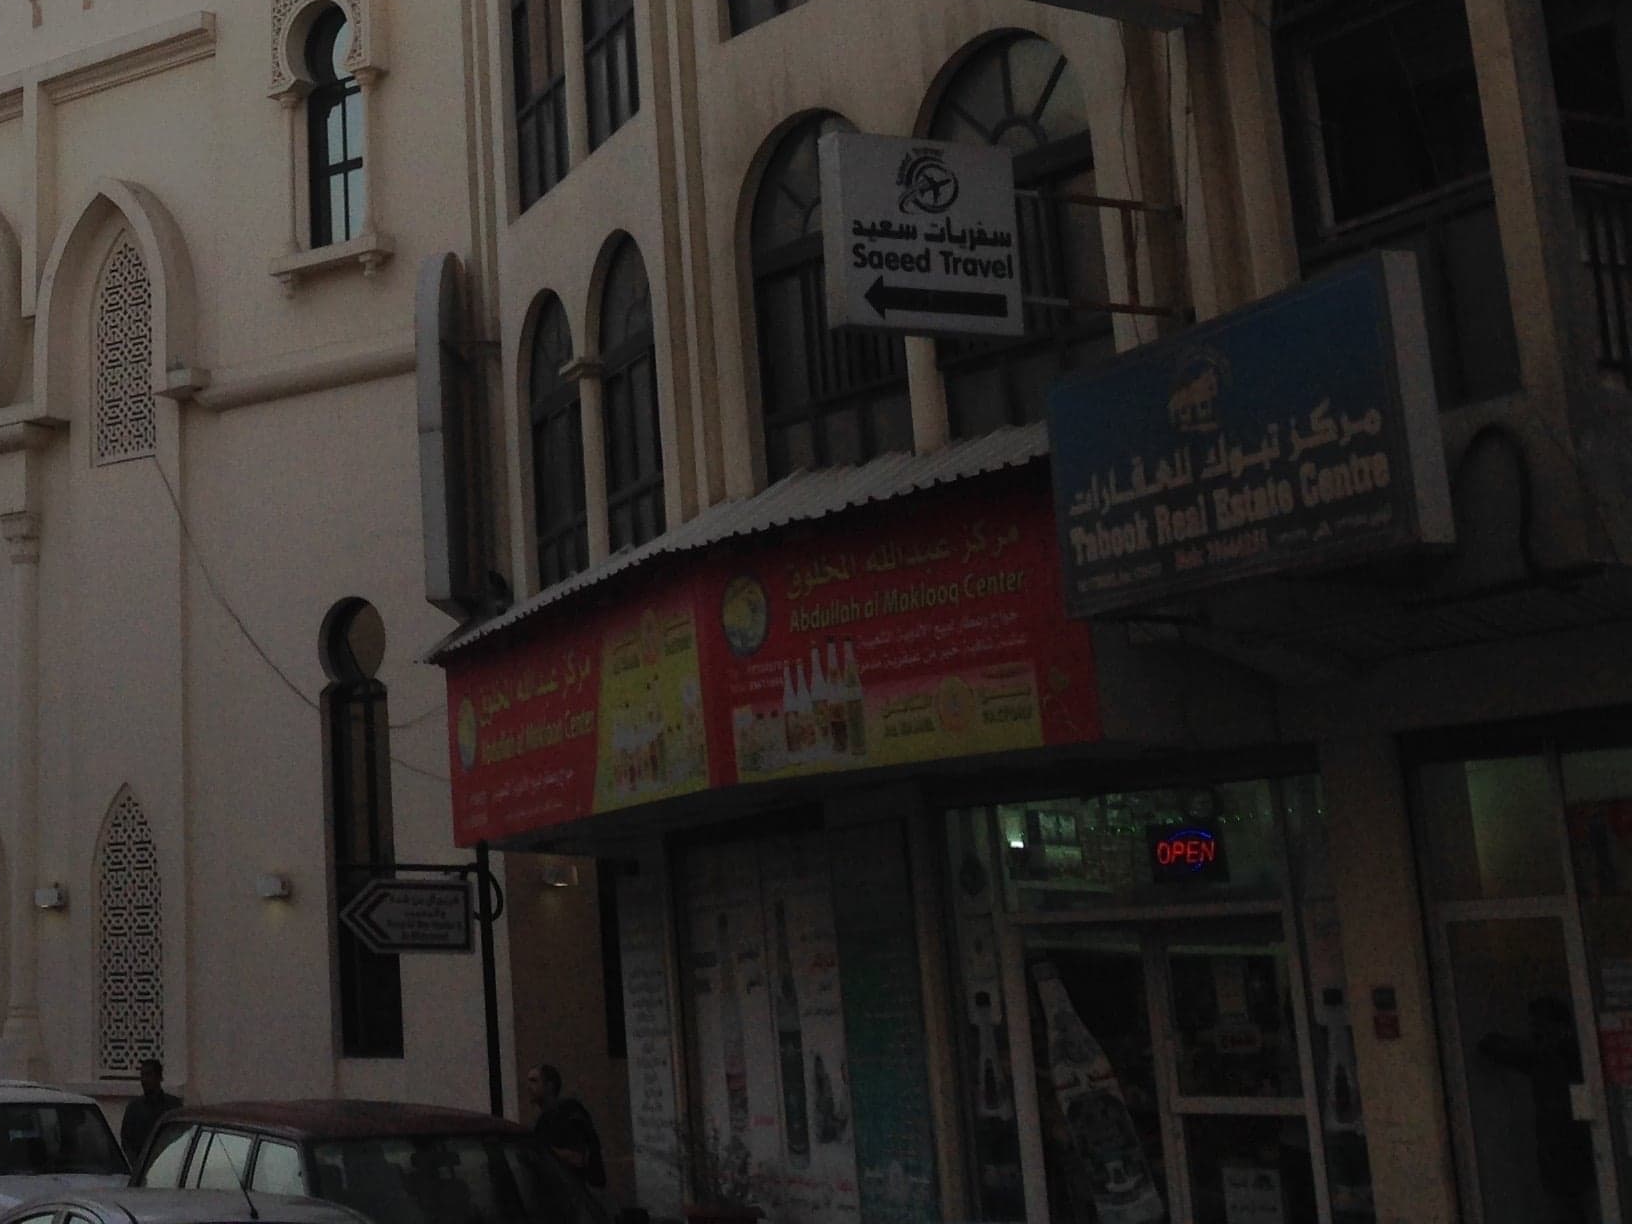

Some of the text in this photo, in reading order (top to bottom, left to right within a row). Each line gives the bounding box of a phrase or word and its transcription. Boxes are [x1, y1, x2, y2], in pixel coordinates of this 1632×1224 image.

[852, 216, 1012, 252] سفريات سعيد
[852, 242, 1014, 280] Saeed Travel
[1289, 396, 1383, 463] مركز
[1068, 510, 1152, 567] Tabook
[1153, 492, 1209, 546] Real
[1212, 476, 1295, 531] Estate
[1298, 451, 1393, 509] Centre
[789, 598, 861, 634] Abdullah
[882, 576, 960, 616] Maklooq
[963, 569, 1026, 598] Center
[1156, 838, 1216, 866] OPEN
